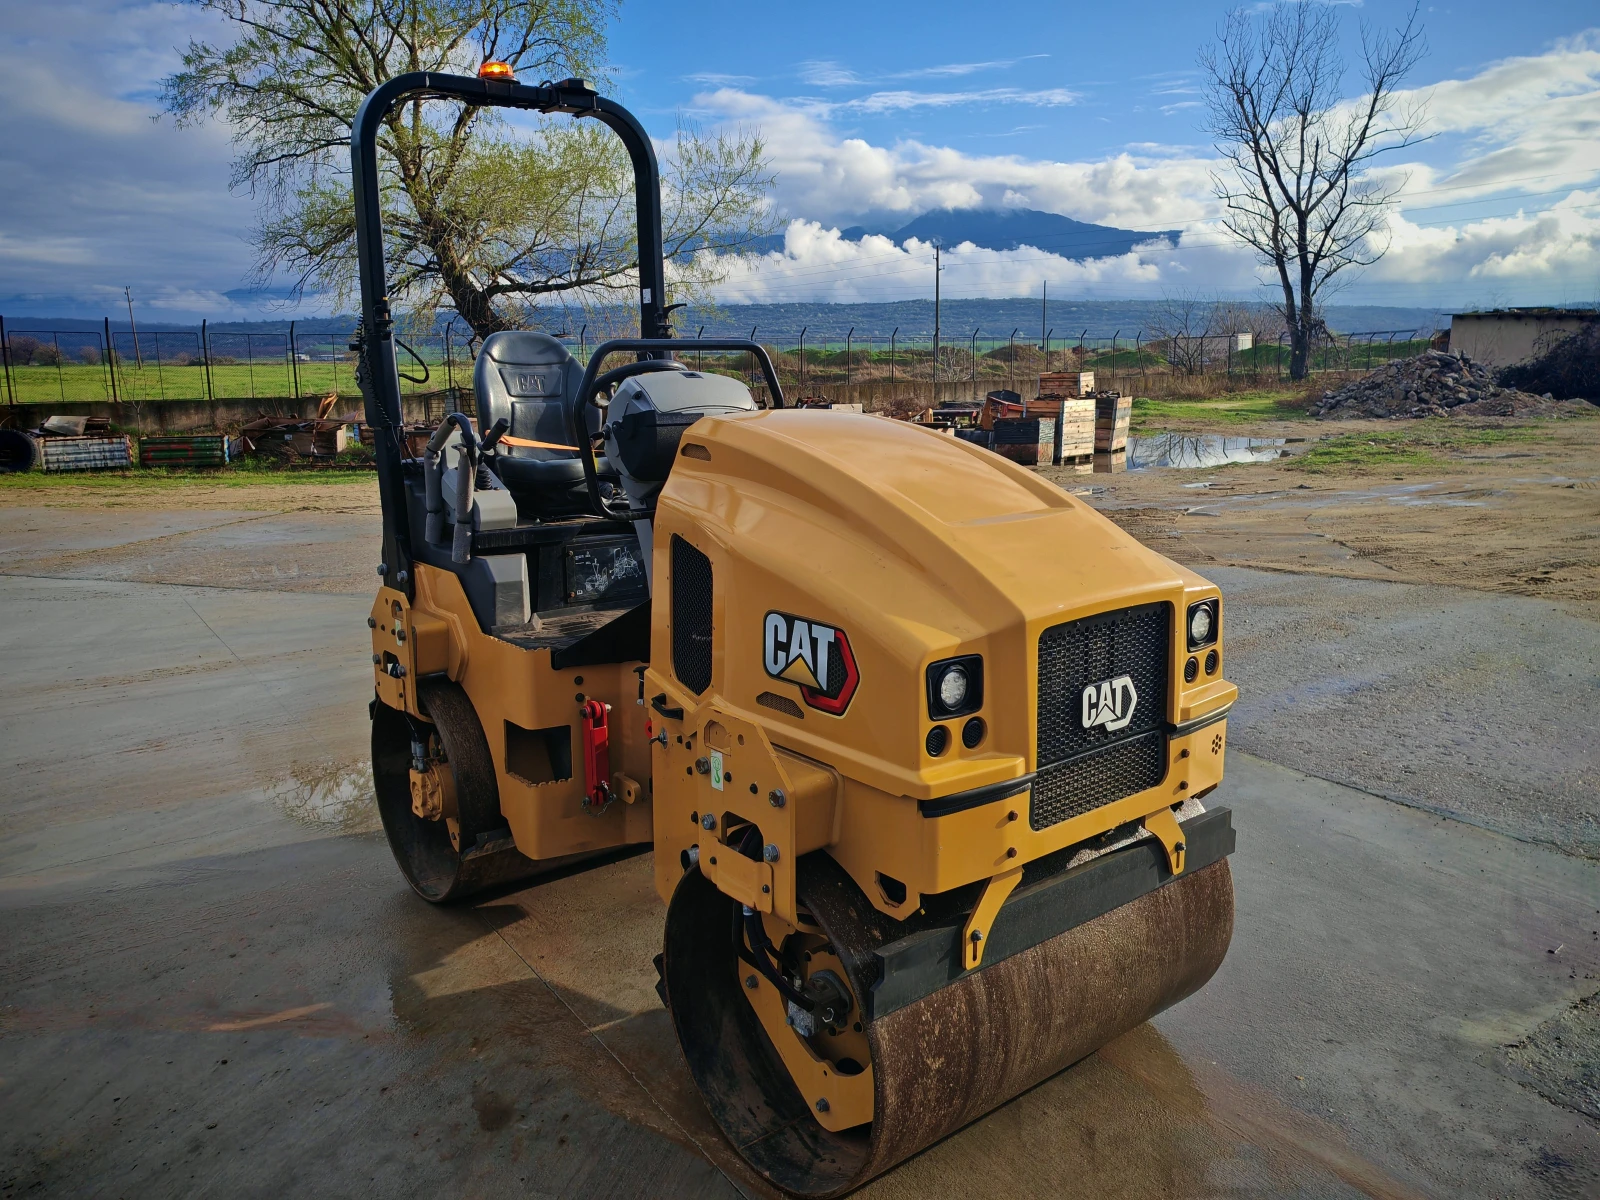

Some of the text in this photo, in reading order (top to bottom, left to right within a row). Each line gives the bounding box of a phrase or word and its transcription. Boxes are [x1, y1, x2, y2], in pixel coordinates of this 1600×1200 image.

[516, 374, 545, 394] CAT
[765, 613, 835, 691] CAT
[1082, 676, 1129, 729] CAT
